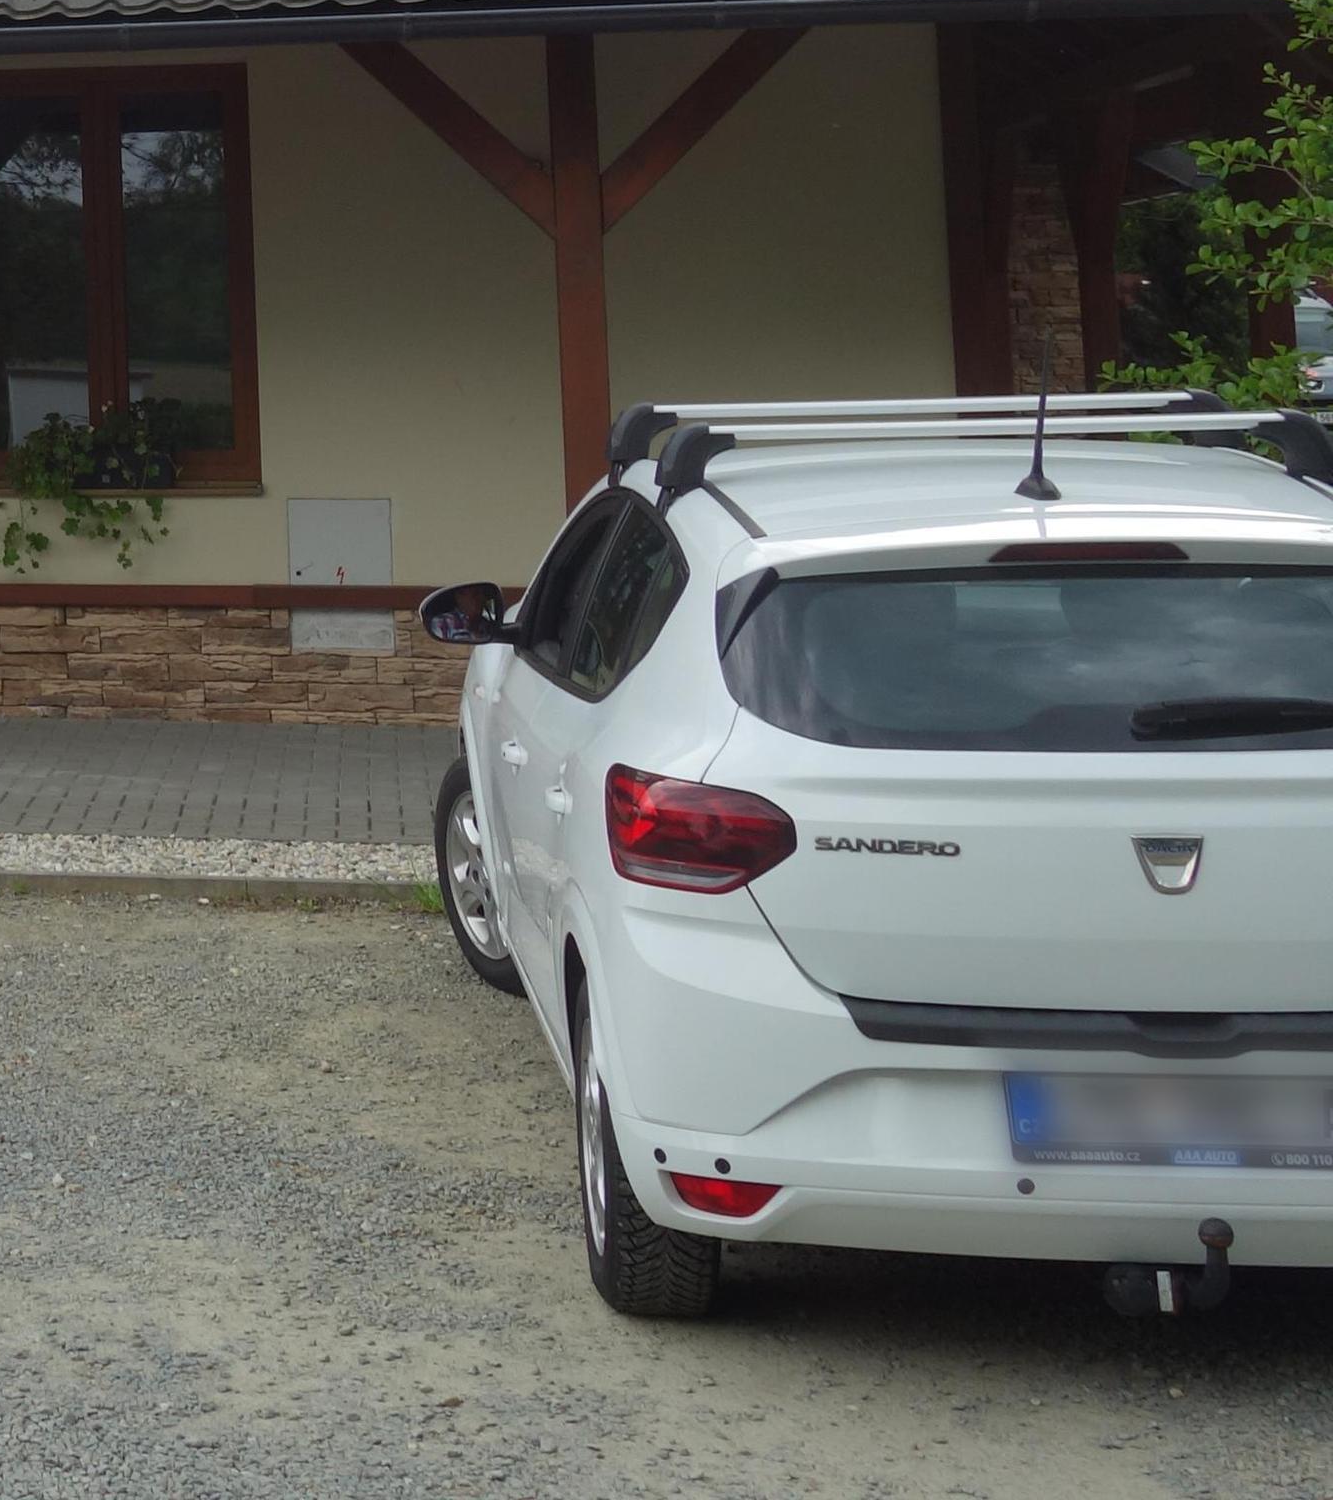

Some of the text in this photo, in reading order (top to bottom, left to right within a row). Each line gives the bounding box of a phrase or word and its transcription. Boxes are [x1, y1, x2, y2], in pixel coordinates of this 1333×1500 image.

[814, 836, 961, 858] SANDERO
[1174, 1149, 1237, 1162] AAA AUTO
[1286, 1153, 1333, 1166] 800 110
